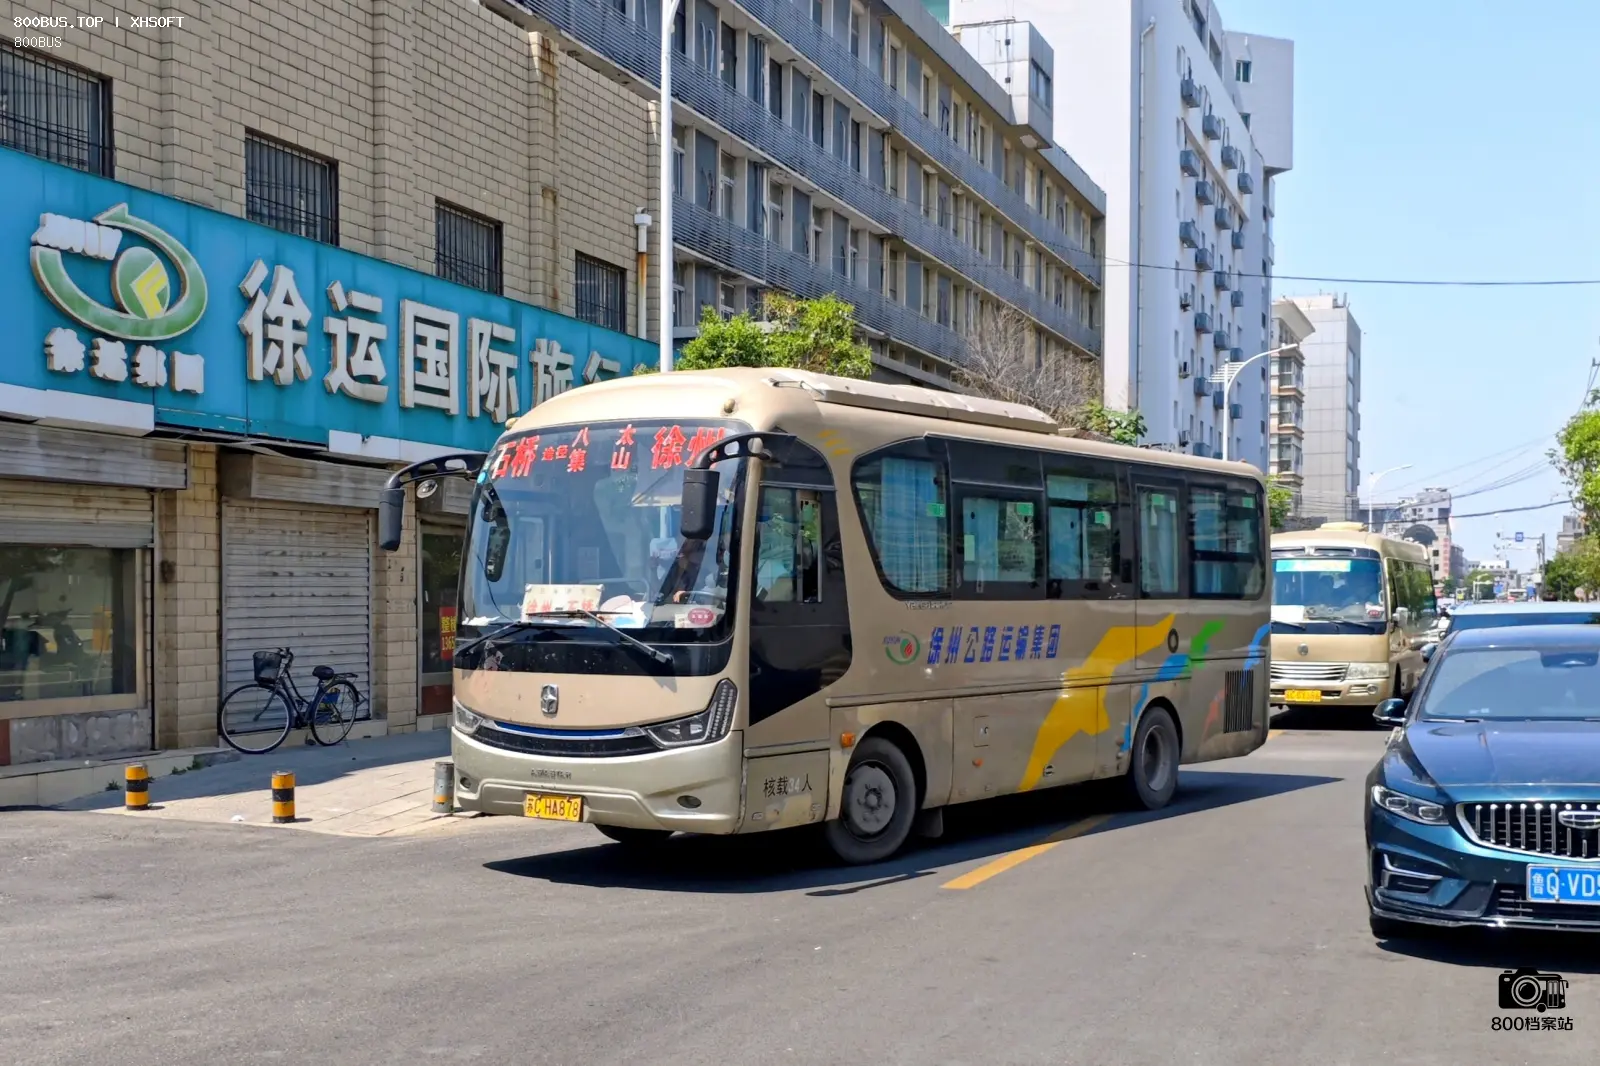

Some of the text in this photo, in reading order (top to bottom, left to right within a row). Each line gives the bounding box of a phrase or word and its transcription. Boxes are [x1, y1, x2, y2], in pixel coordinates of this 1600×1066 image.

[927, 624, 1062, 665] 徐州公路运输集团
